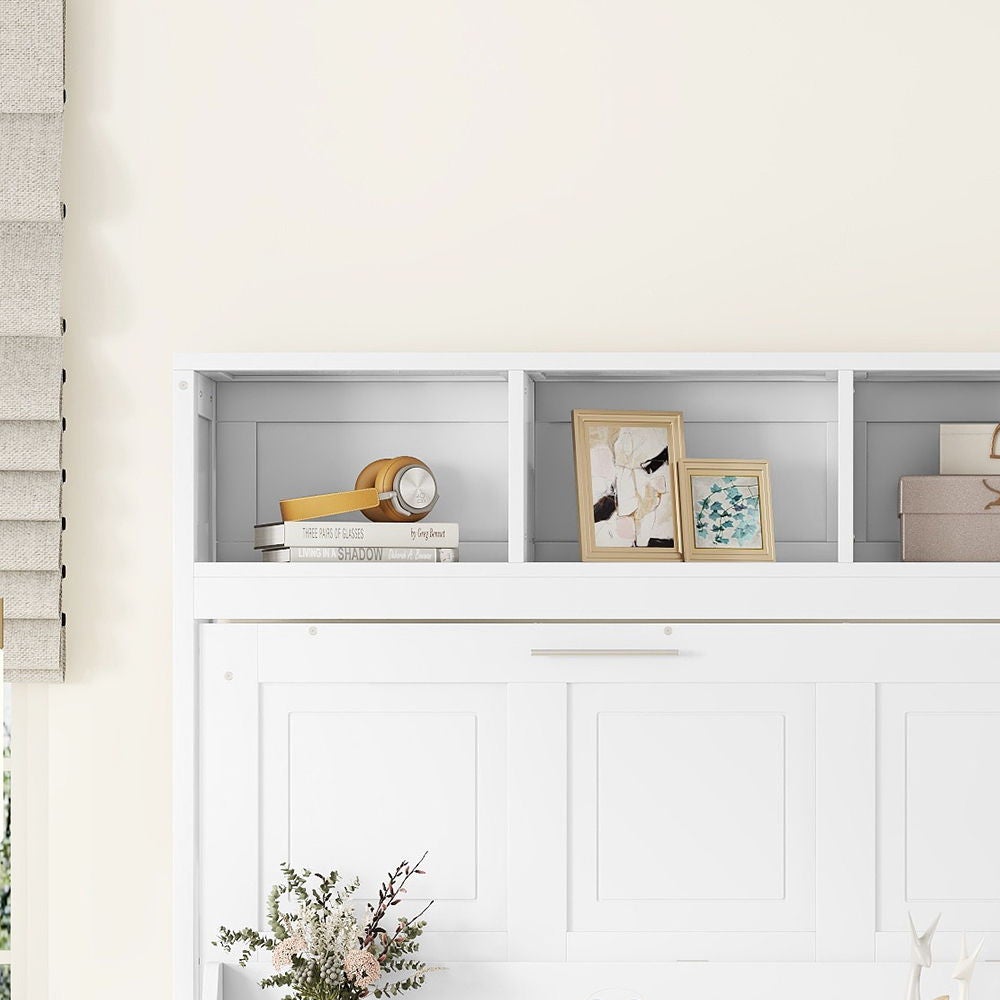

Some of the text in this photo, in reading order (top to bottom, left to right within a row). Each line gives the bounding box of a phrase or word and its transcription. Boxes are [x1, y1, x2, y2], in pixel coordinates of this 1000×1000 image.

[302, 527, 364, 539] THREE PAIRS OF GLASSES
[410, 528, 417, 541] by
[337, 547, 383, 561] SHADOW
